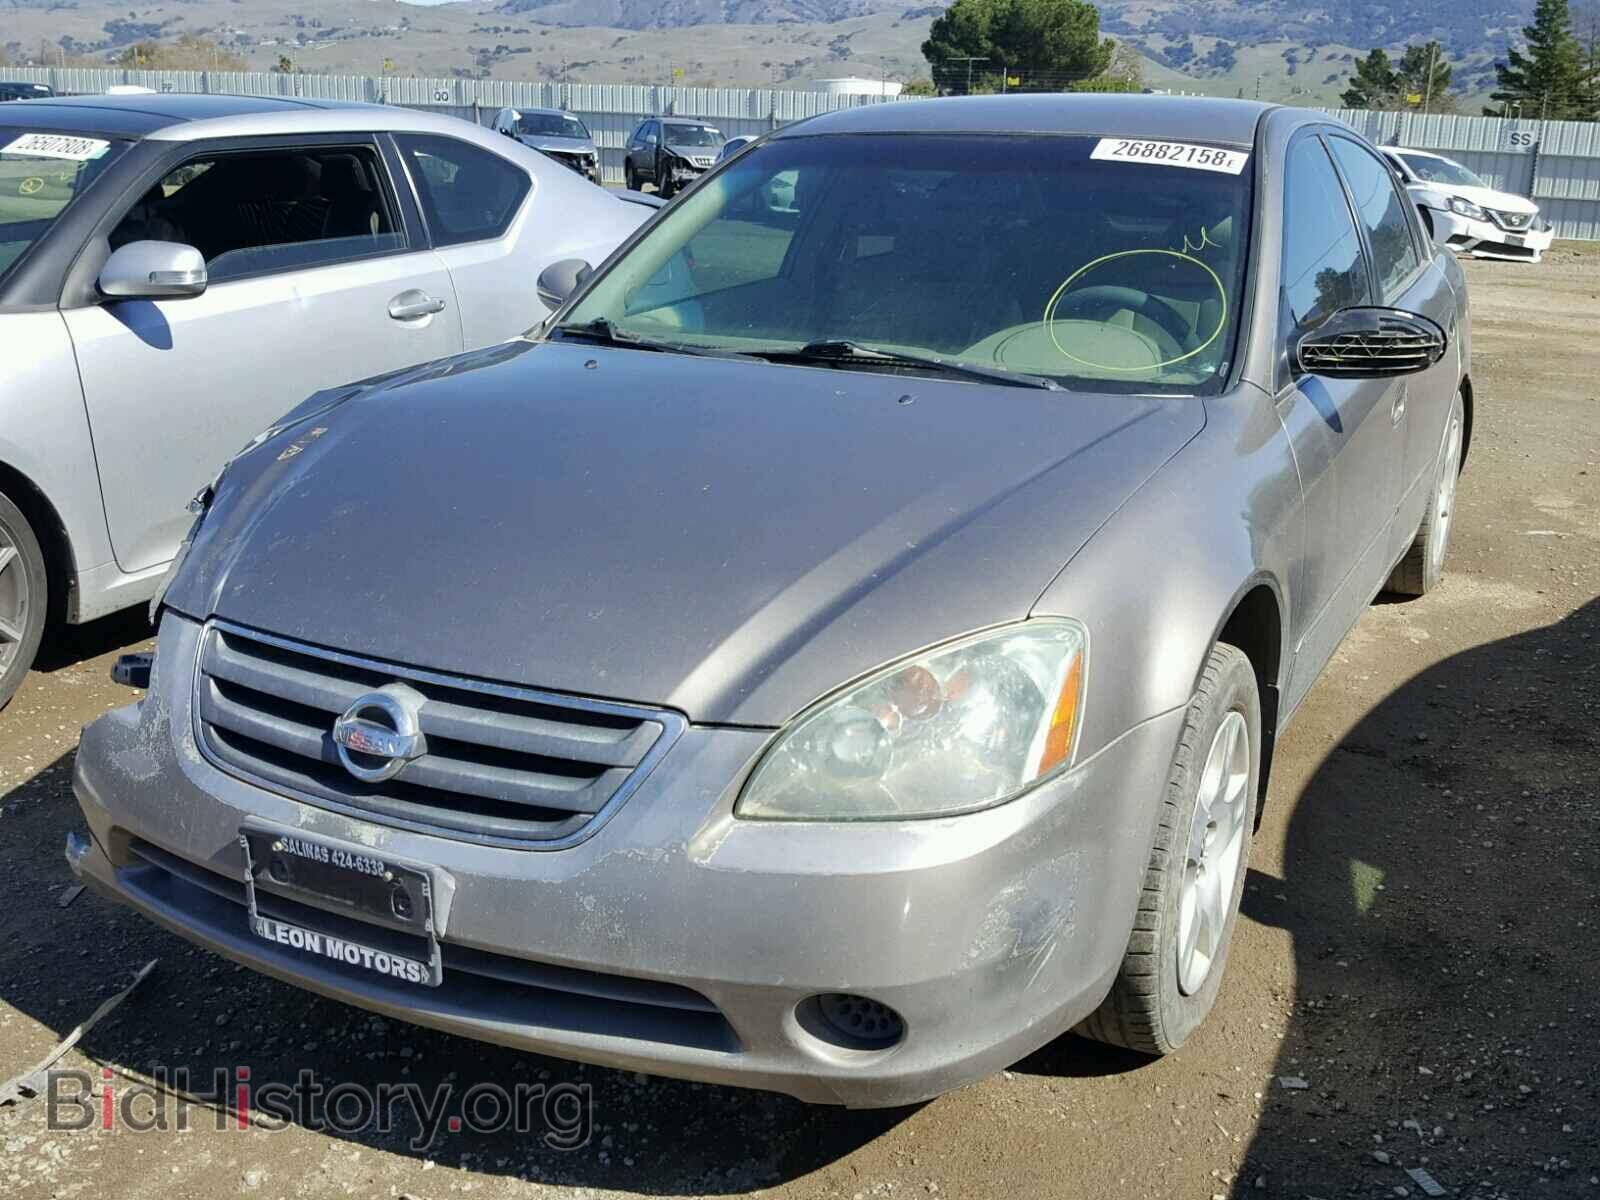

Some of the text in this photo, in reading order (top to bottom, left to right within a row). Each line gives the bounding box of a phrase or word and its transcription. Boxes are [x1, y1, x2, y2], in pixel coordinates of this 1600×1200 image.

[1510, 132, 1532, 146] SS
[280, 835, 329, 864] SALINAS
[263, 919, 421, 983] LEON MOTORS
